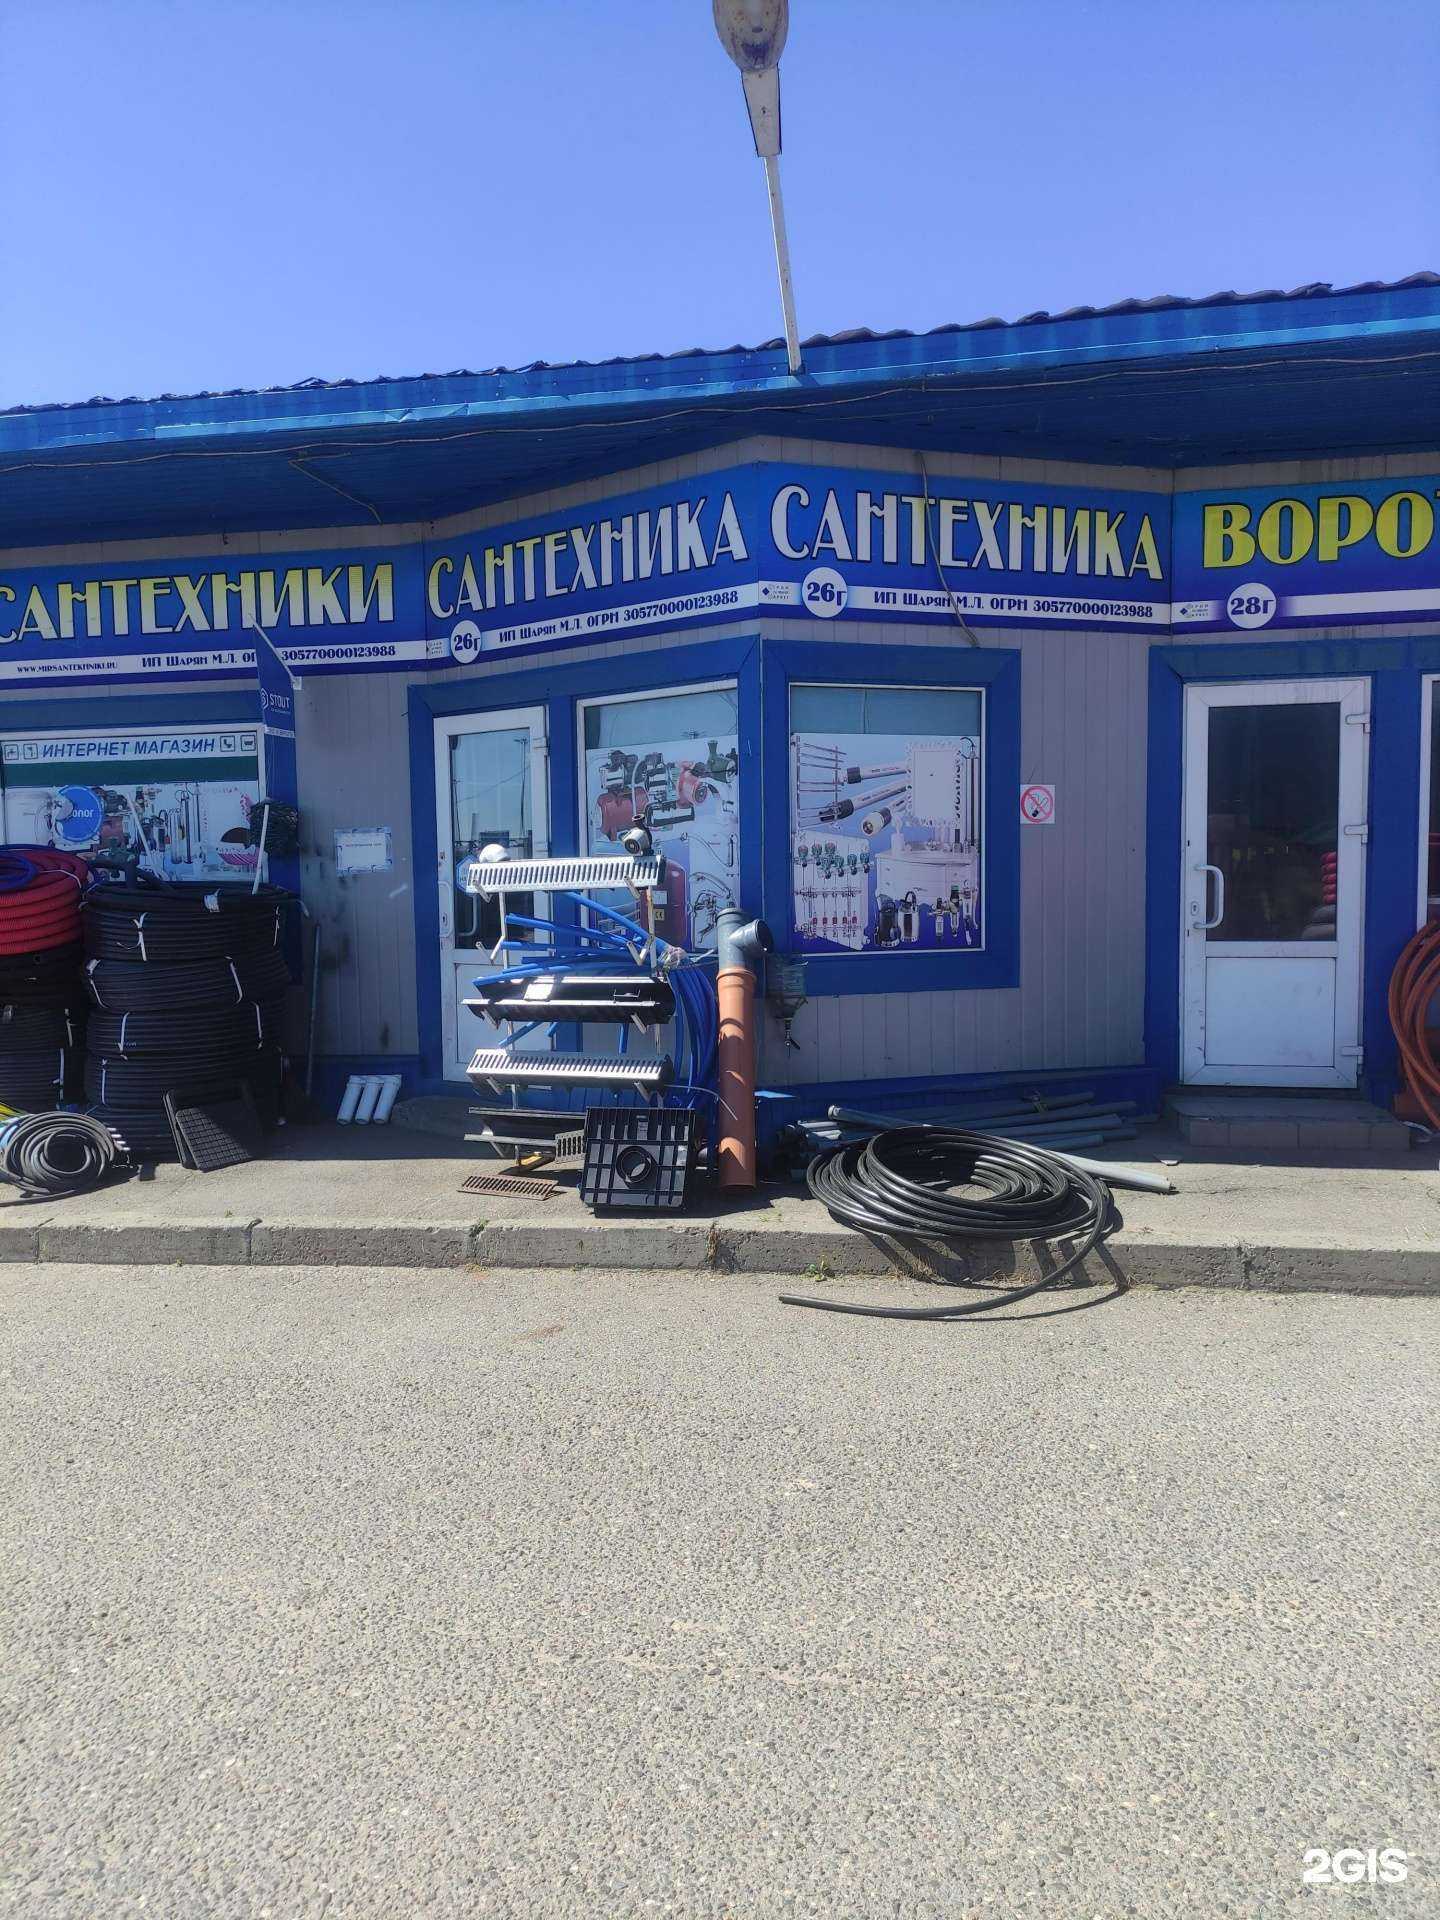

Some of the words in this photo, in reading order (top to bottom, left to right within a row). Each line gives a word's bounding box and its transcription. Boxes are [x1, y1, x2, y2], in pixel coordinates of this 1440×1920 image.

[771, 484, 1163, 581] САНТЕХНИКА
[1203, 490, 1440, 568] ВОРО
[428, 491, 749, 619] САНТЕХНИКА
[499, 629, 516, 642] ИП
[587, 611, 619, 628] ОГРН
[623, 590, 739, 622] 305770000123988
[874, 591, 897, 604] ИП
[990, 597, 1028, 611] ОГРН
[1033, 600, 1153, 618] 305770000123988
[142, 657, 161, 668] ИП
[281, 645, 396, 661] 305770000123988
[270, 693, 290, 708] STOUT
[42, 740, 130, 758] ИНТЕРНЕТ
[134, 738, 215, 755] МАГАЗИН
